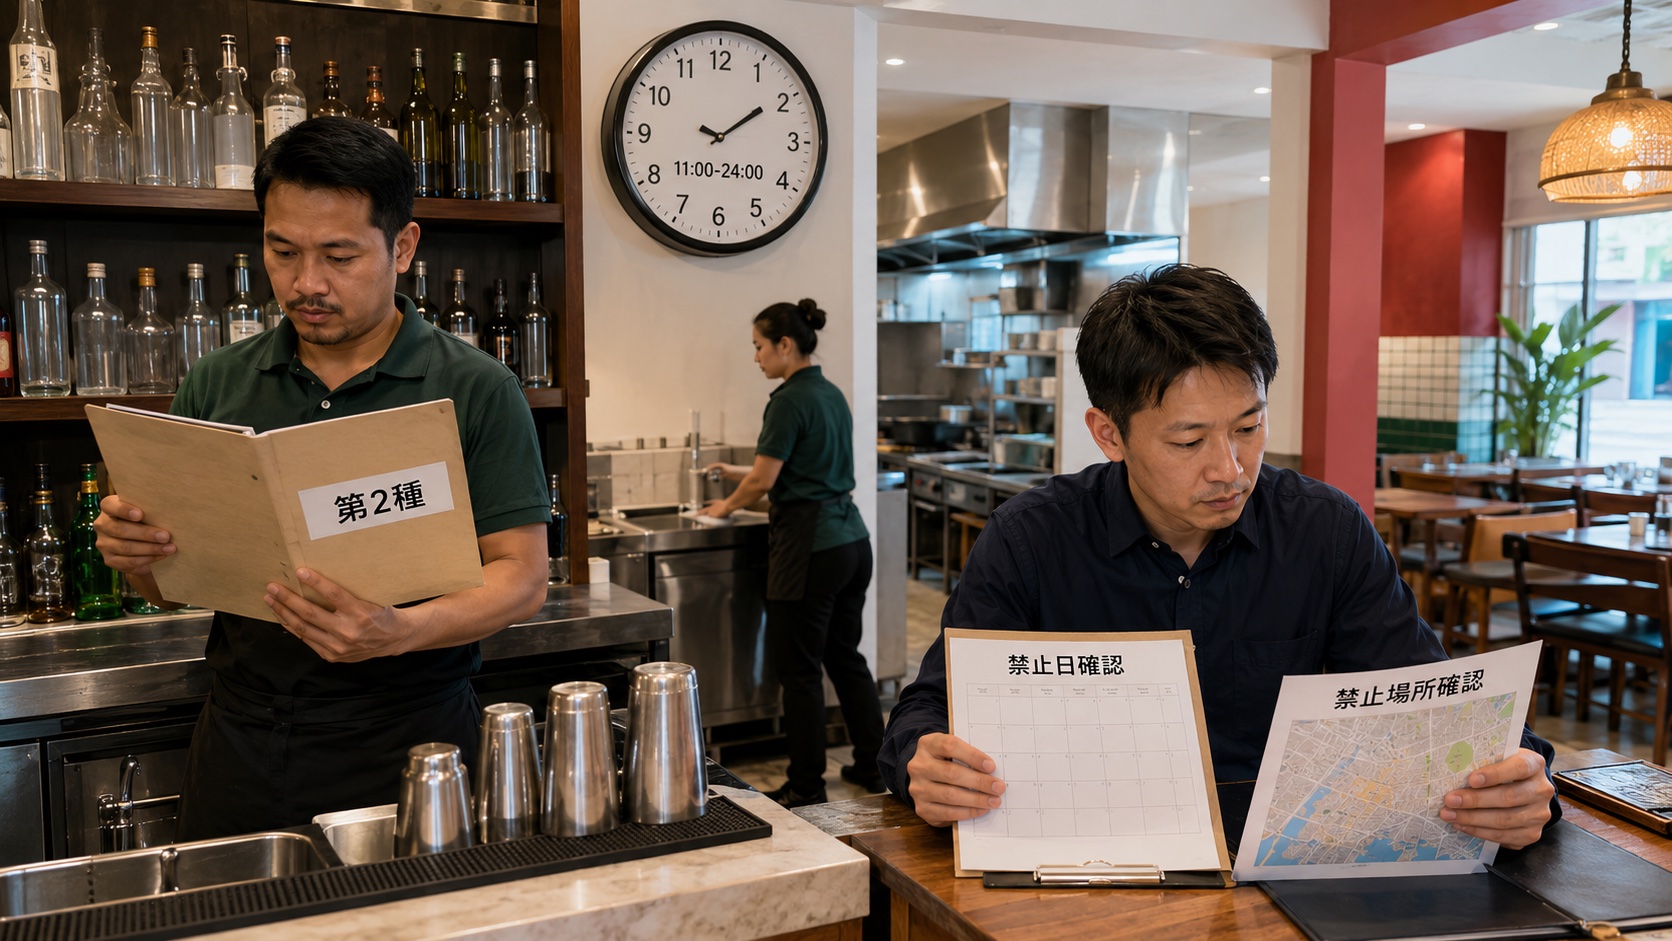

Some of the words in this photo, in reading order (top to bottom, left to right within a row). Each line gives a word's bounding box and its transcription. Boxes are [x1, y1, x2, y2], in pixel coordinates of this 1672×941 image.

[677, 58, 693, 79] 11
[710, 50, 731, 71] 12
[753, 62, 760, 83] 1
[649, 86, 670, 106] 10
[777, 93, 789, 112] 2
[638, 123, 651, 143] 9
[787, 132, 800, 152] 3
[648, 164, 660, 184] 8
[674, 160, 764, 180] 11:00-24:00
[776, 171, 789, 190] 4
[676, 194, 689, 214] 7
[750, 198, 762, 218] 5
[712, 206, 725, 227] 6
[333, 479, 426, 524] 第2種
[1008, 654, 1125, 676] 禁止日確認
[1334, 668, 1485, 710] 禁止場所確認
